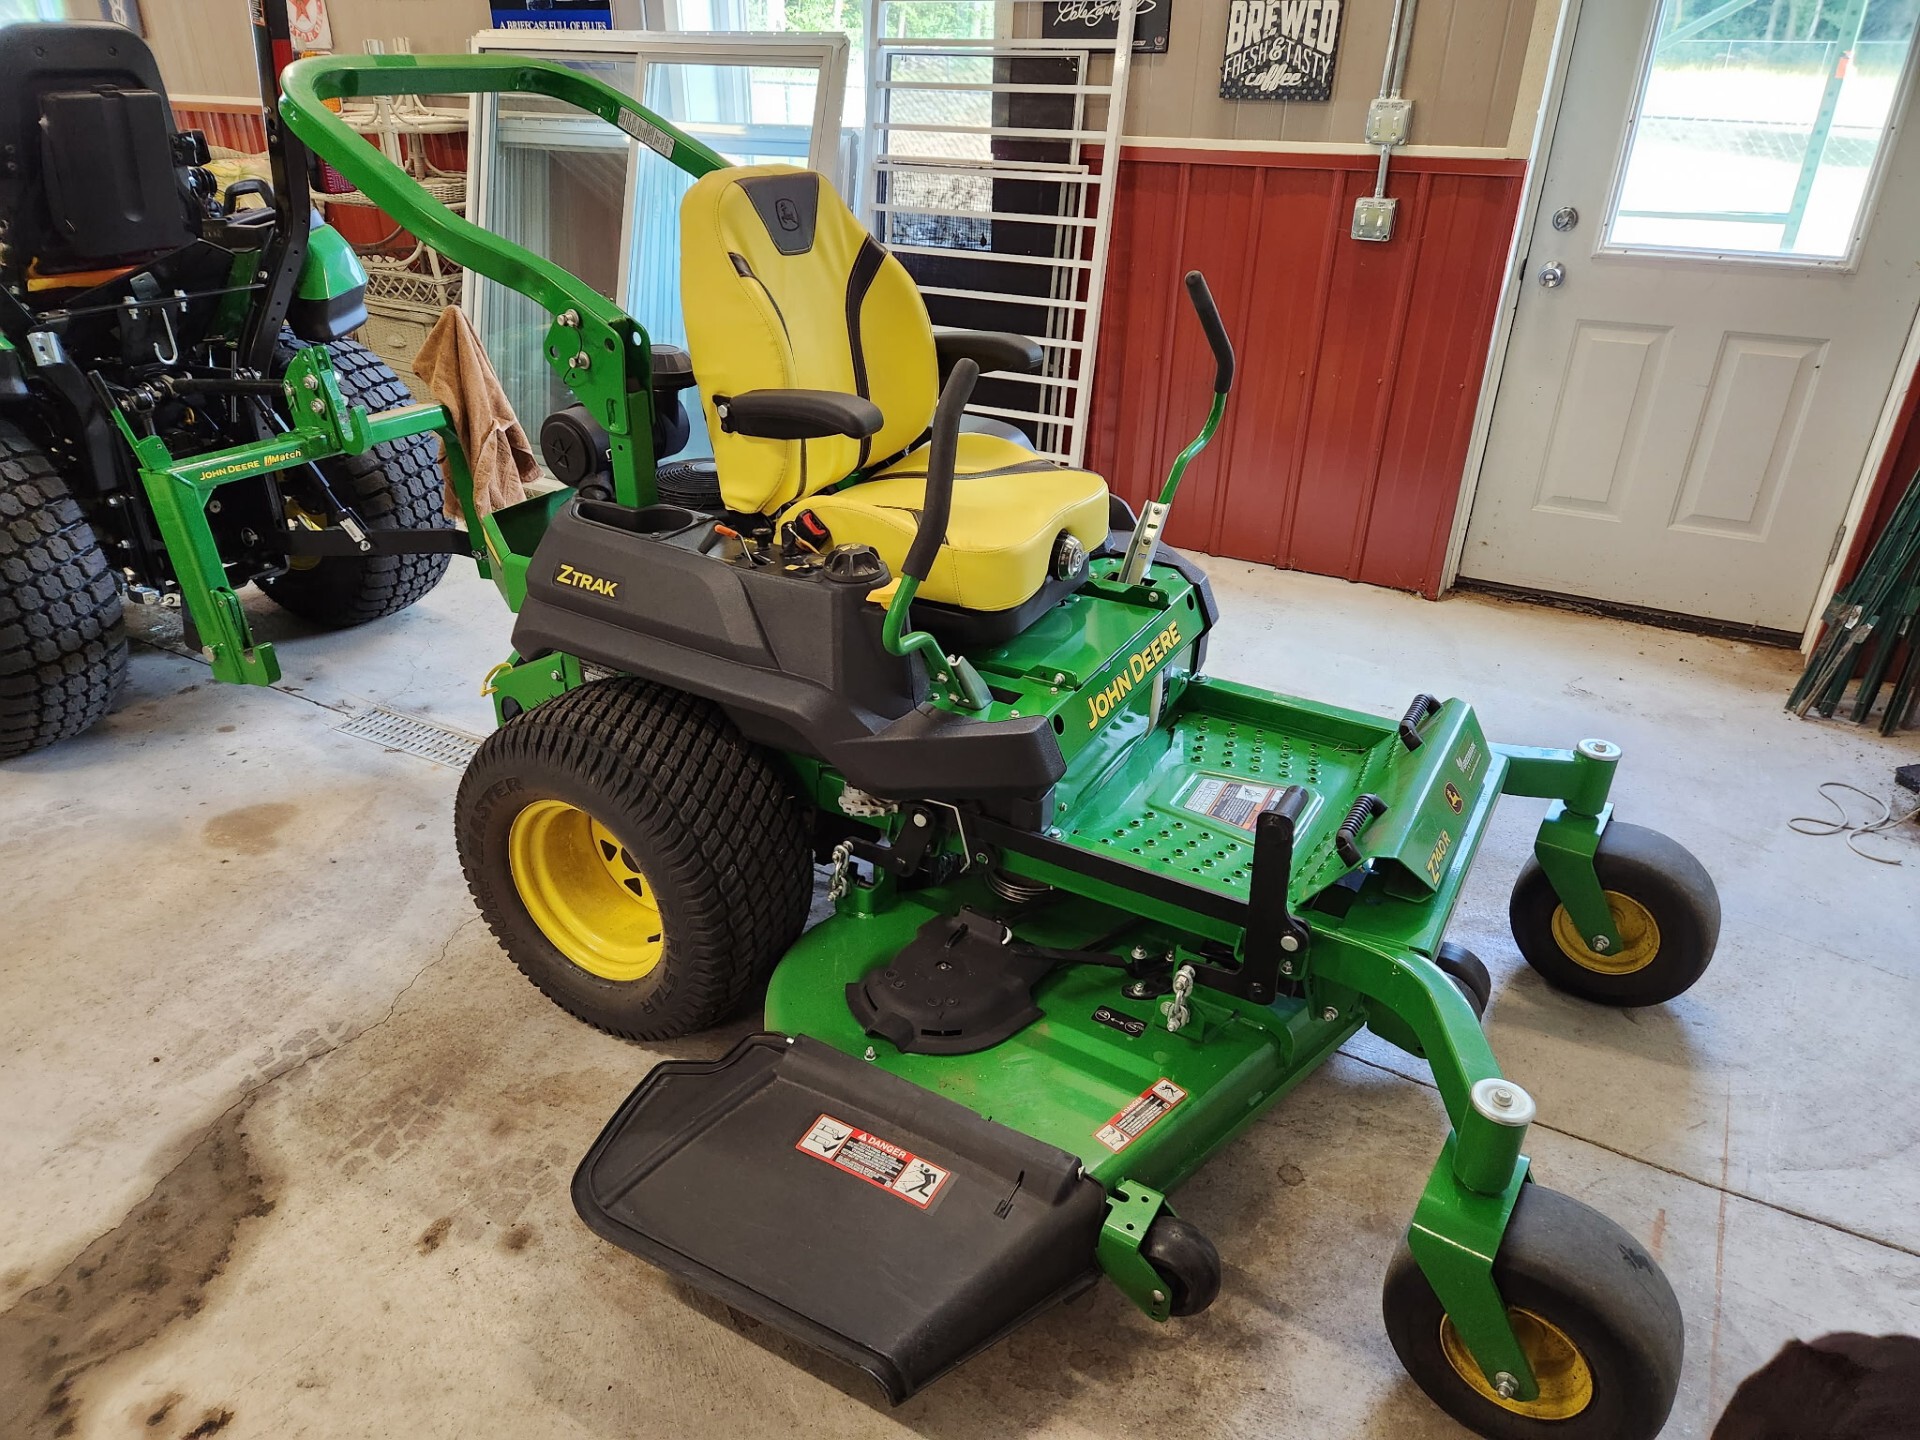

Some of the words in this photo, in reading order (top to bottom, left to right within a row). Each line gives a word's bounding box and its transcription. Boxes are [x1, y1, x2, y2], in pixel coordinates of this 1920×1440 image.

[506, 20, 549, 30] BRIEFCASE
[549, 20, 567, 30] FULL
[581, 21, 607, 31] BLUES
[1226, 0, 1340, 56] BREWED
[1224, 40, 1270, 83] FRESH
[1269, 36, 1286, 61] &
[1286, 39, 1332, 84] TASTY
[1244, 63, 1303, 92] coffee
[200, 468, 227, 481] JOHN
[227, 460, 260, 473] DEERE
[556, 563, 619, 598] ZTRAK
[1086, 668, 1133, 732] JOHN
[1129, 620, 1183, 684] DEERE
[1426, 829, 1452, 886] Z740R
[868, 1137, 906, 1158] DANGER
